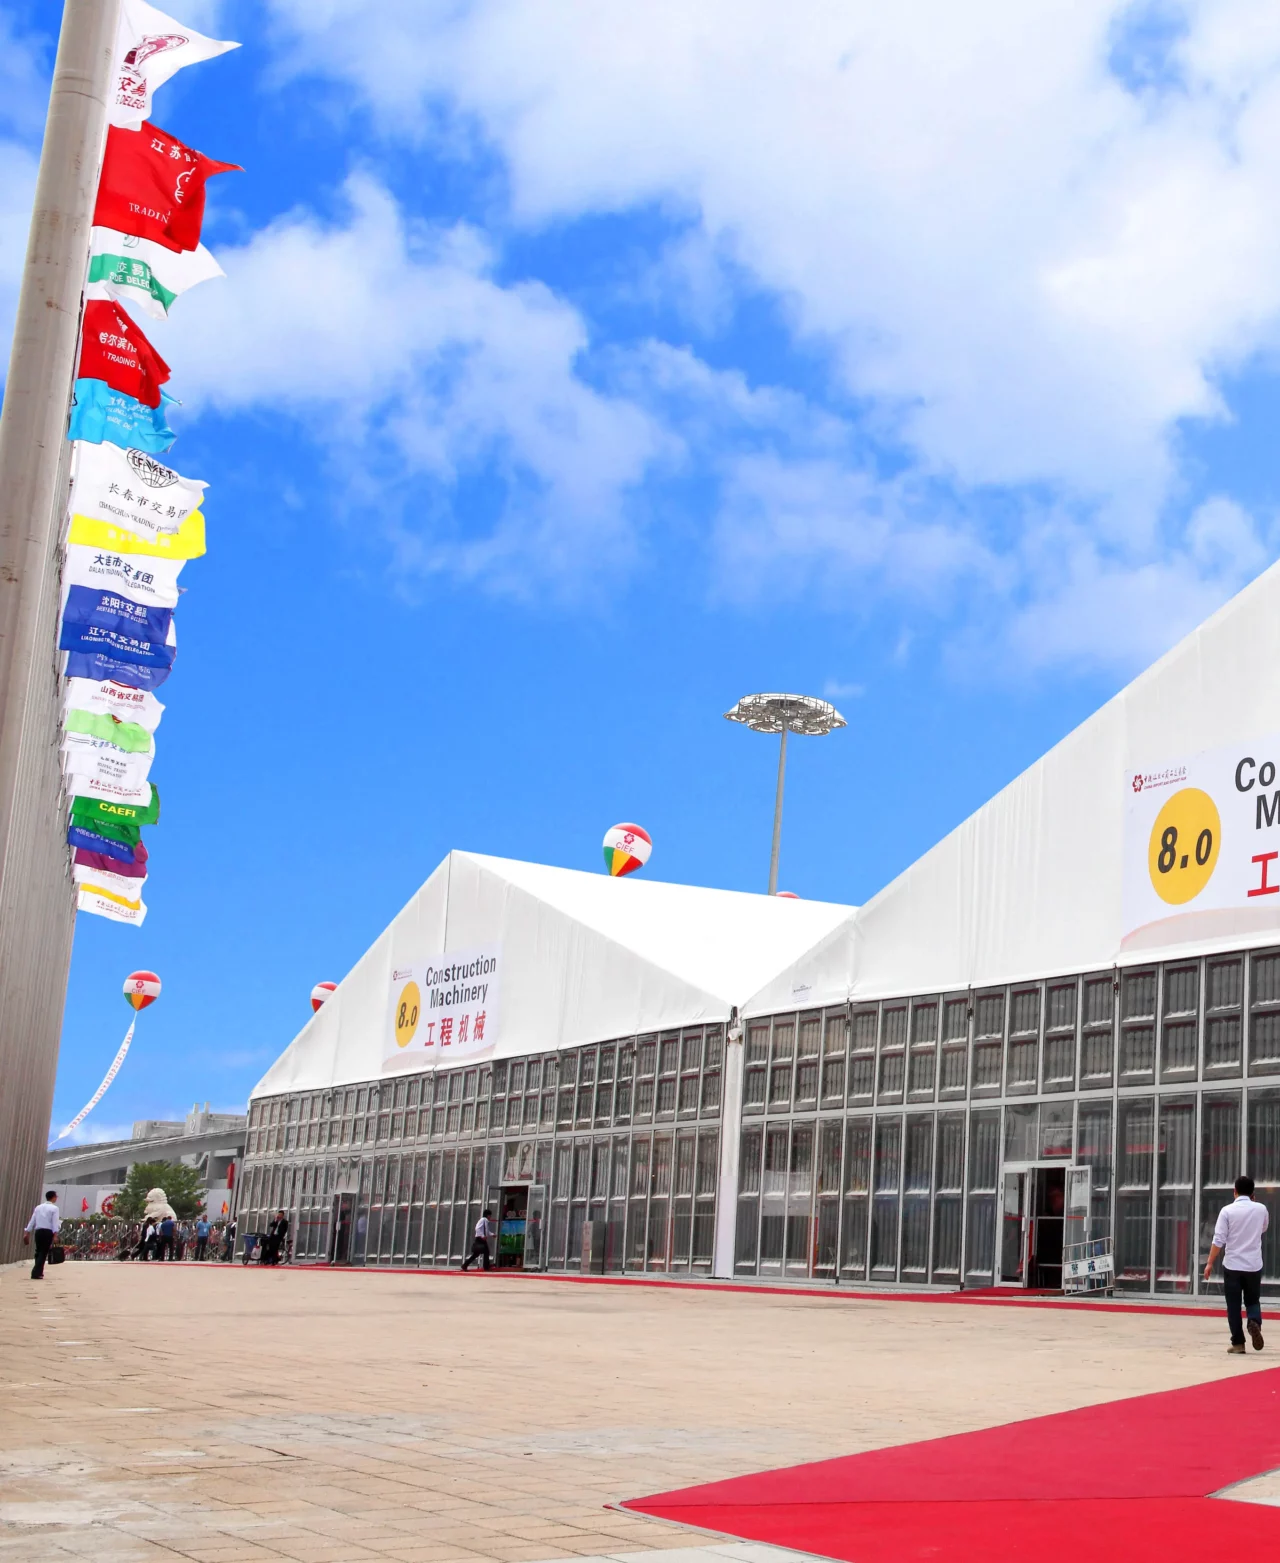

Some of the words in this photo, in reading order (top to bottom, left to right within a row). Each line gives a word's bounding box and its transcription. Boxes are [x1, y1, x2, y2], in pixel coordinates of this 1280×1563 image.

[107, 352, 136, 368] TRADING
[108, 482, 188, 520] 长春市交易团
[99, 802, 136, 819] CAEFI
[615, 841, 635, 854] CIEF
[1157, 825, 1213, 875] 8.0
[426, 955, 497, 987] Construction
[429, 983, 489, 1009] Machinery
[397, 1002, 418, 1029] 8.0
[424, 1010, 486, 1047] 工程机械
